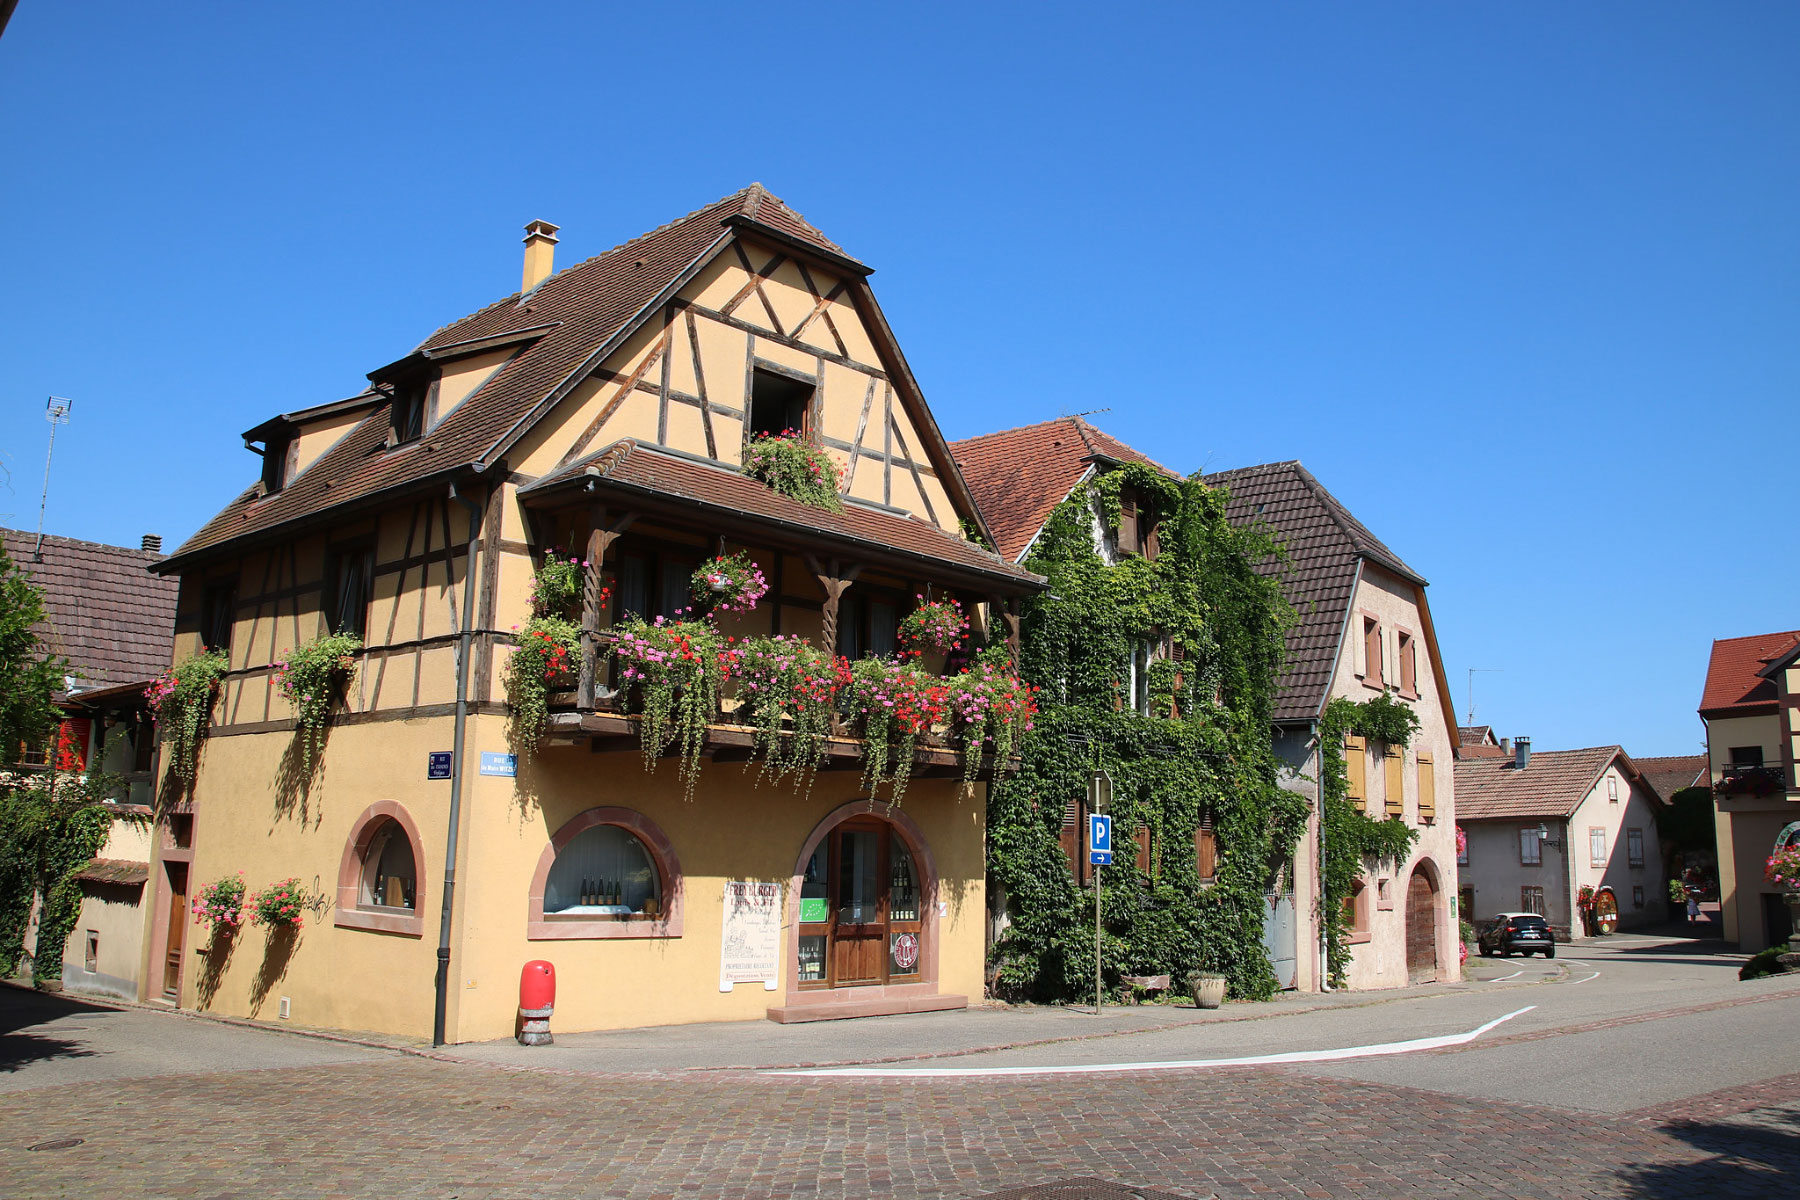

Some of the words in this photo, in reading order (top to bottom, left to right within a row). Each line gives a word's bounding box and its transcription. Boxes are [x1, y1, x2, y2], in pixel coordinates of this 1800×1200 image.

[493, 756, 505, 764] RUE
[1096, 822, 1105, 844] P
[729, 884, 778, 897] FREYBURGER
